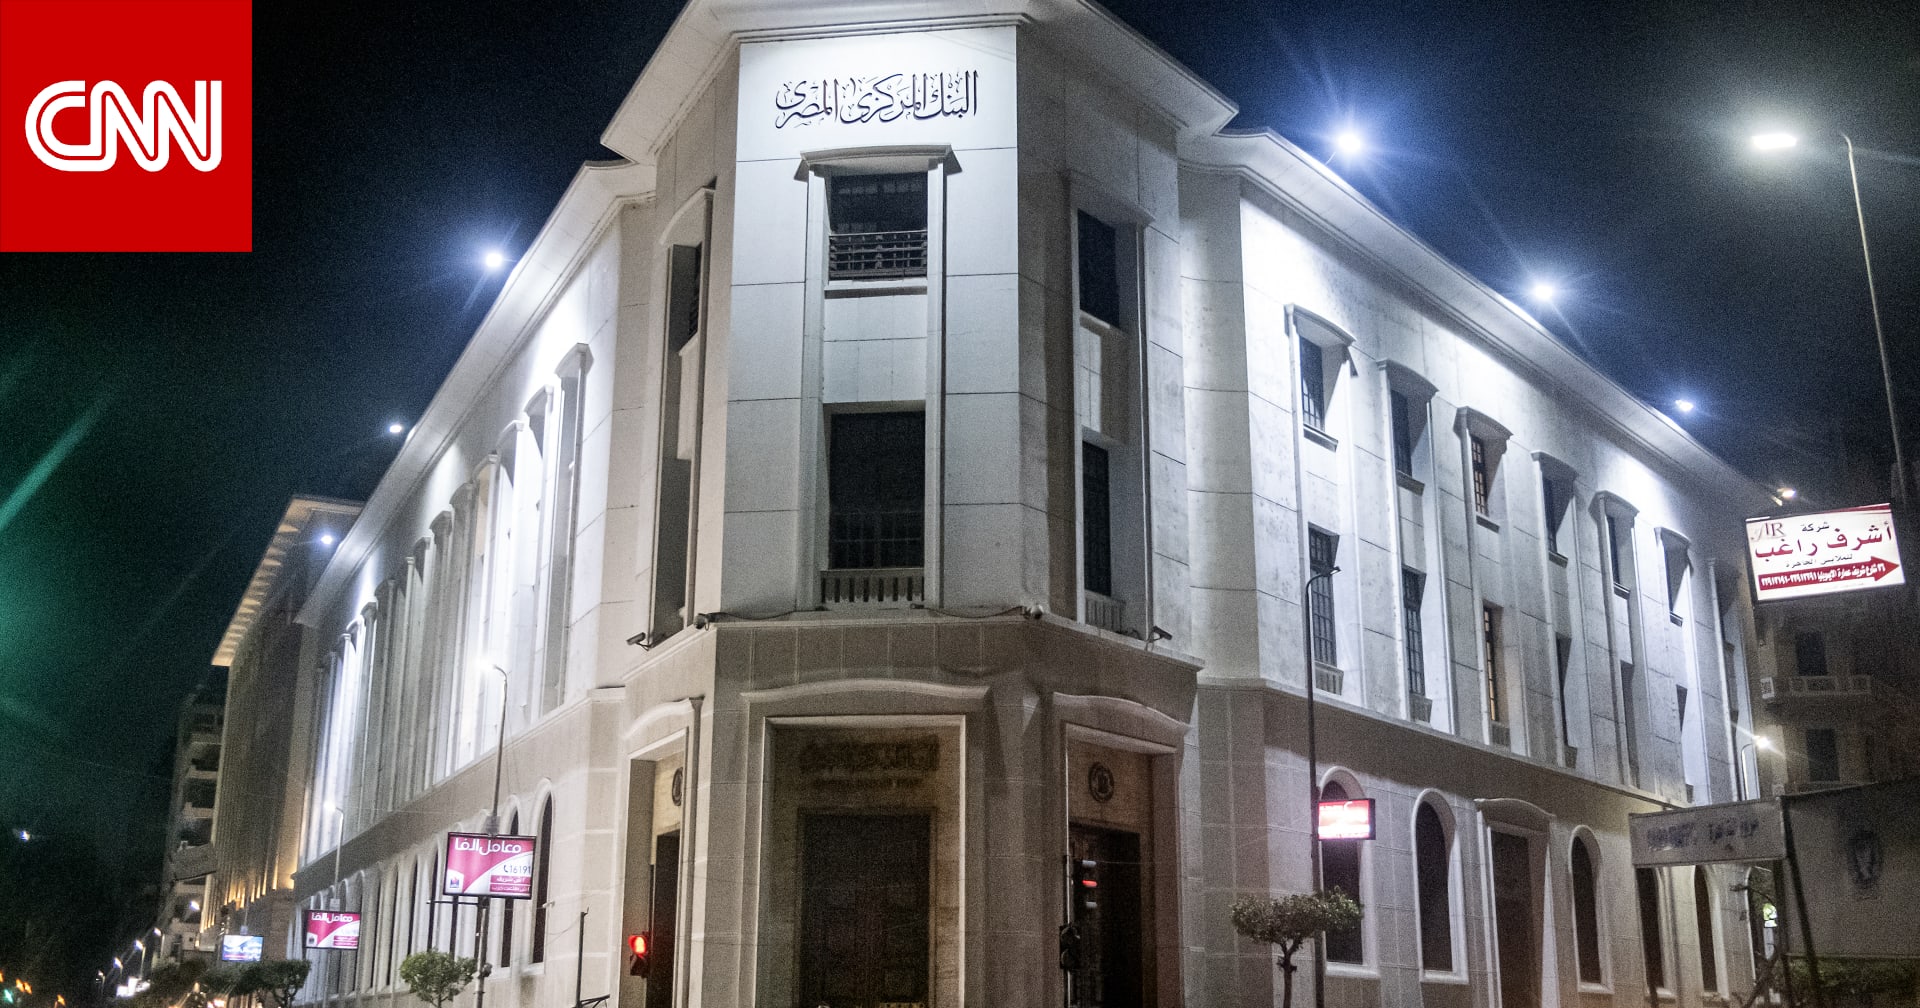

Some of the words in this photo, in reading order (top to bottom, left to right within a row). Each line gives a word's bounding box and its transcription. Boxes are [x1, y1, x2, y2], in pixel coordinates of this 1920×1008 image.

[913, 70, 979, 120] البنك
[1801, 521, 1830, 532] شركة
[1827, 520, 1892, 551] أشرف
[1755, 538, 1818, 562] راغب
[479, 839, 522, 855] معامل
[510, 865, 531, 874] 16191
